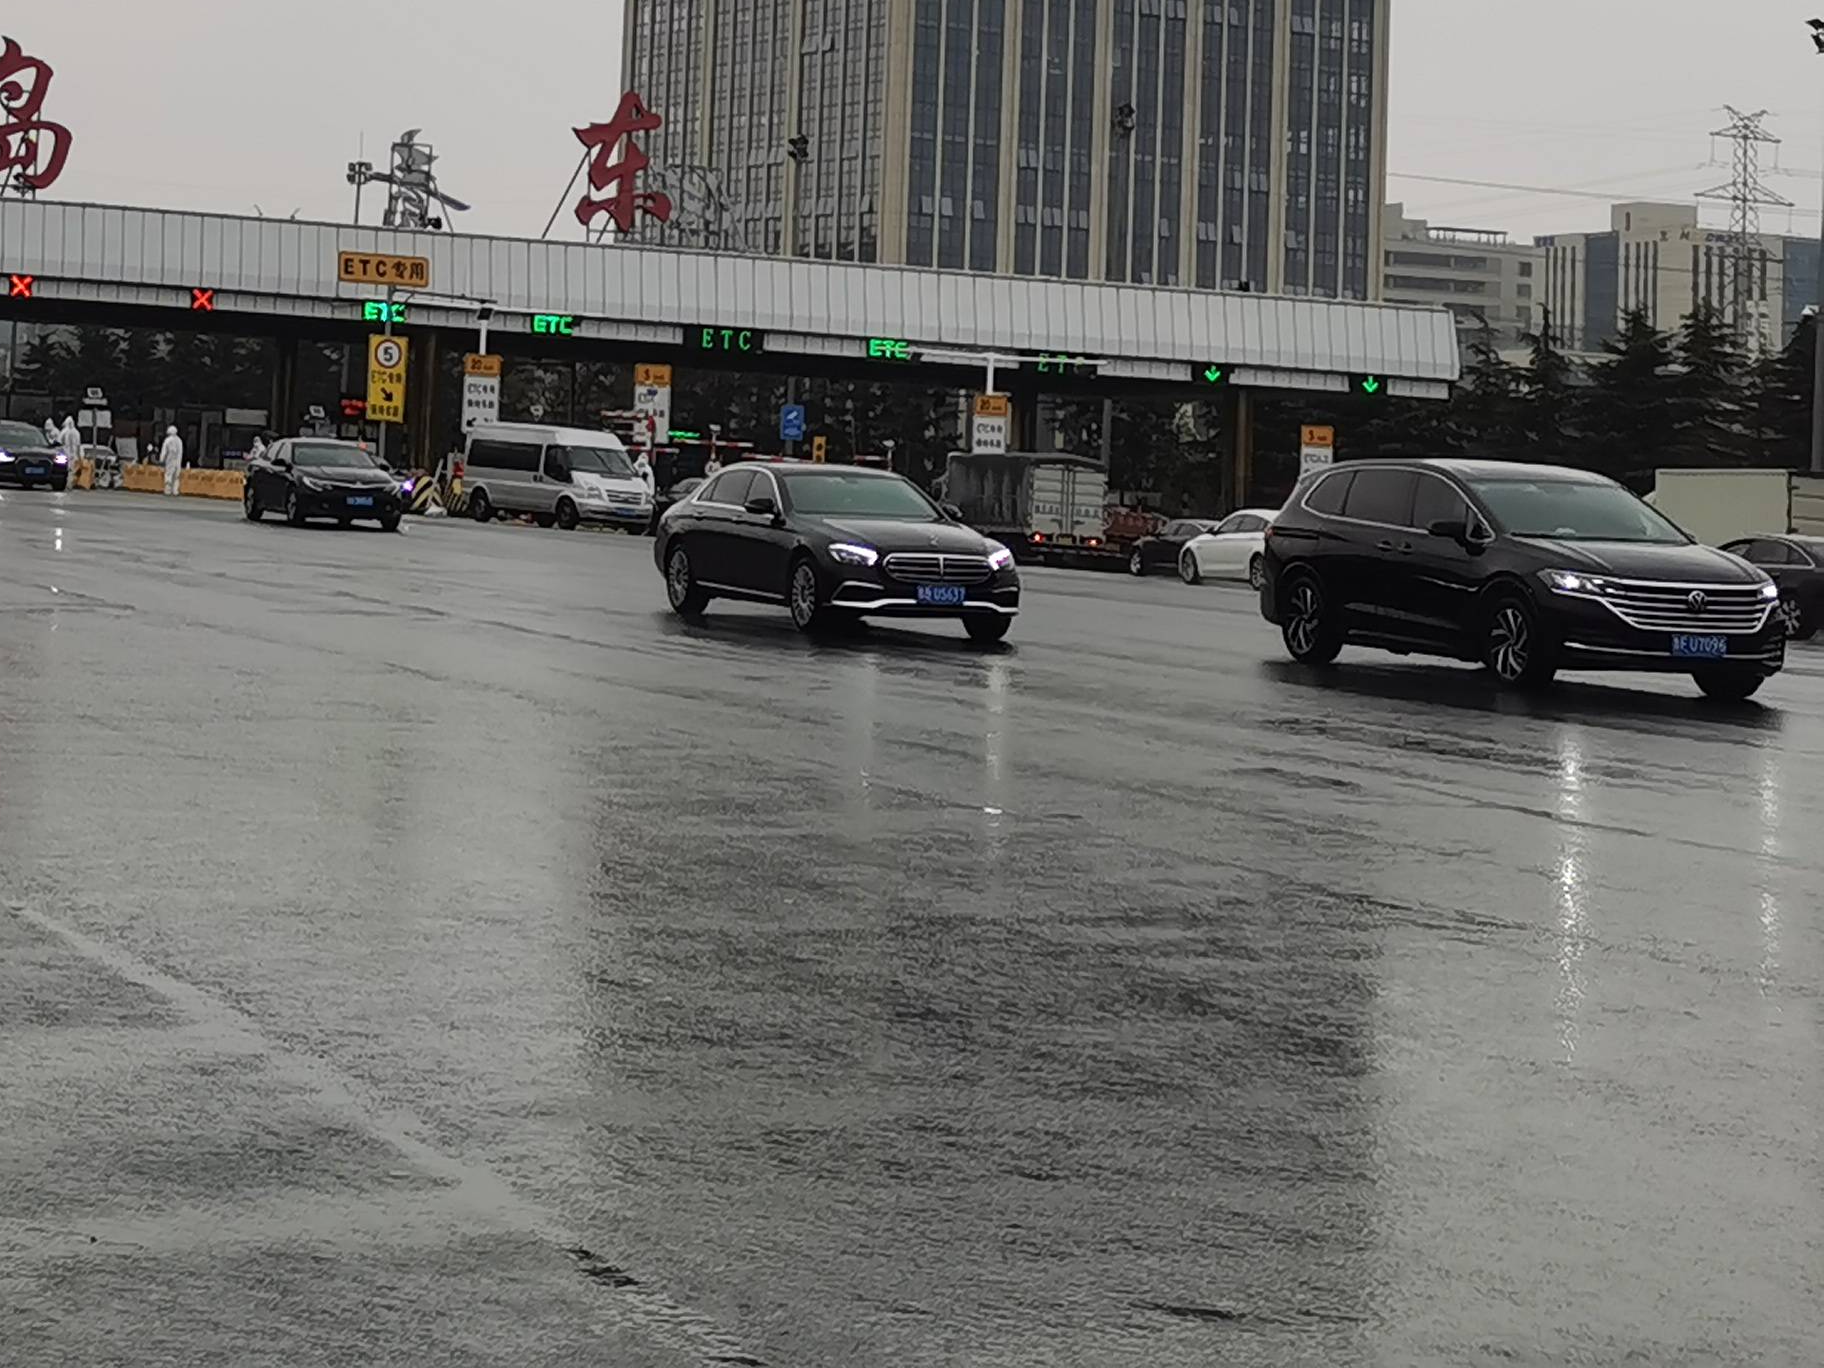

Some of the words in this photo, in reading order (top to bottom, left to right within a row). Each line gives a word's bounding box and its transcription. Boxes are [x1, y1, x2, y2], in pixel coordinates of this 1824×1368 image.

[533, 315, 573, 334] ETC
[702, 328, 751, 350] ETC
[869, 339, 907, 358] ETC
[383, 346, 394, 362] 5
